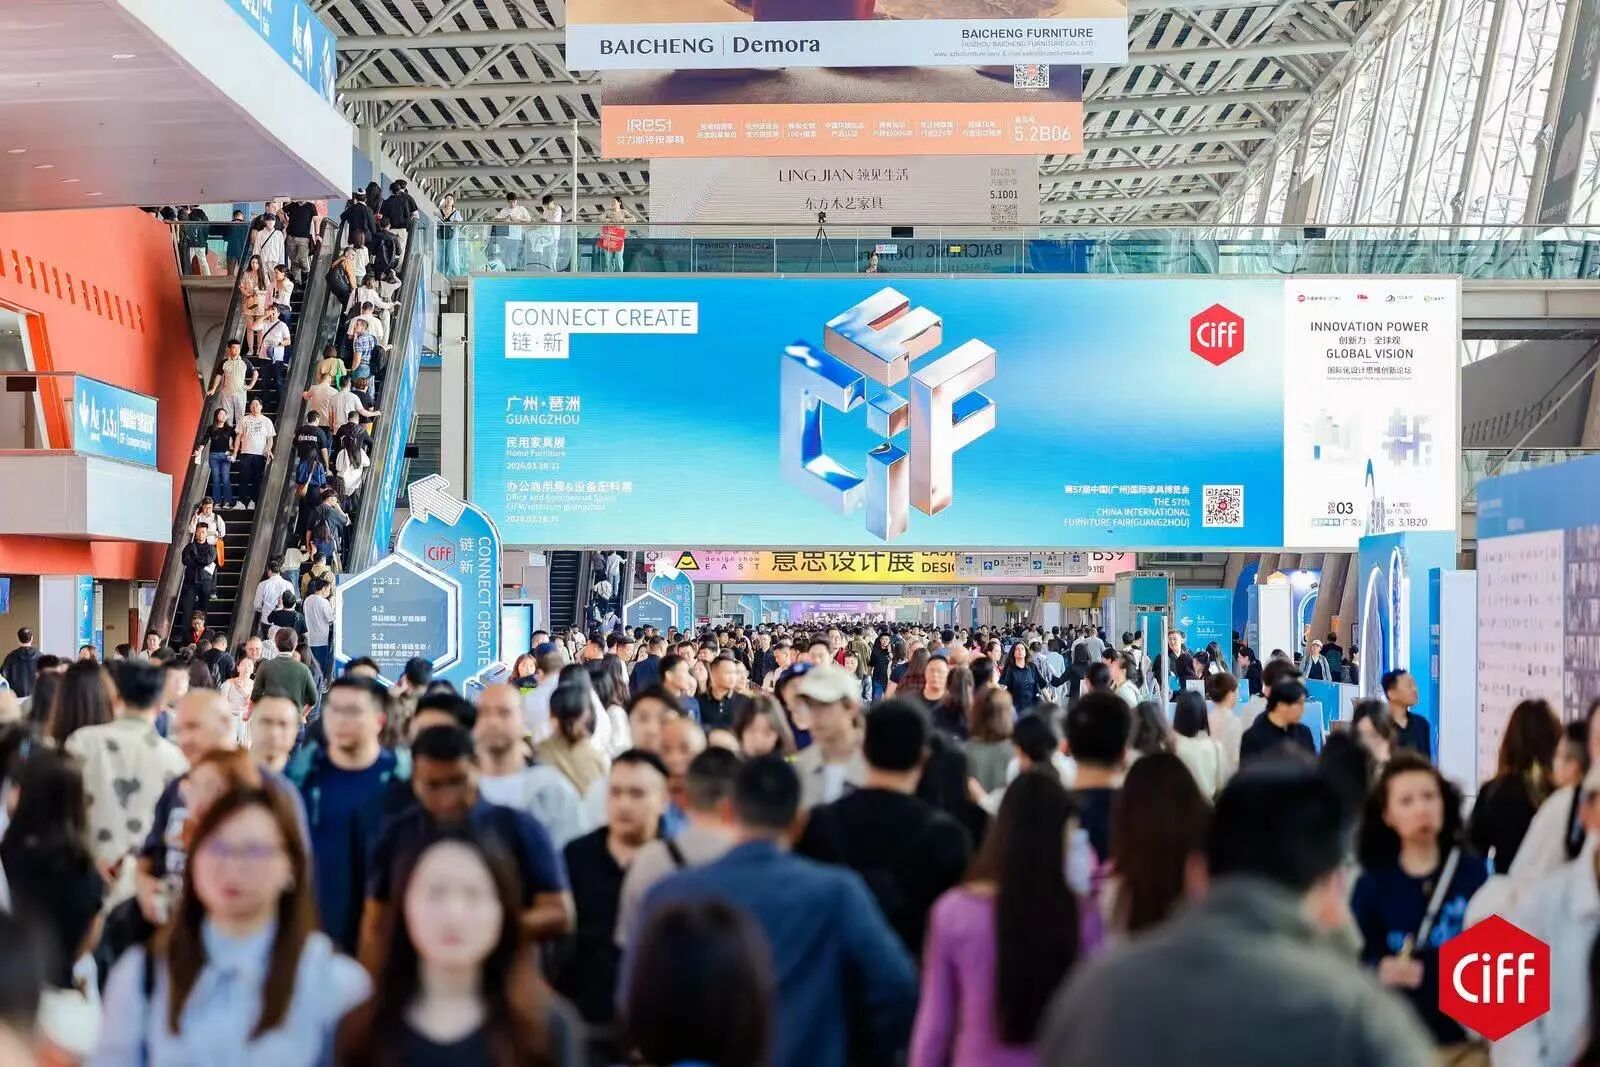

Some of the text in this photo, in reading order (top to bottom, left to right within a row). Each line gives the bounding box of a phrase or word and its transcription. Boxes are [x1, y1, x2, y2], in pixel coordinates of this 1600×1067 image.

[962, 28, 1094, 39] BAICHENG FURNITURE
[599, 36, 821, 55] BAICHENG Demora
[1014, 125, 1072, 142] 5.2B06
[779, 168, 910, 182] LING JIAN 领见生活
[990, 190, 1018, 199] 5.1D01
[804, 197, 885, 210] 东方木艺家具
[511, 308, 692, 327] CONNECT CREATE
[1310, 321, 1429, 332] INNOVATION POWER
[511, 331, 563, 353] 链·新
[1326, 348, 1414, 359] GLOBAL VISION
[1327, 366, 1412, 375] 国际化设计思维创新论坛
[506, 396, 581, 412] 广州·琶洲
[506, 414, 580, 425] GUANGZHOU
[506, 436, 566, 449] 民用家具展
[530, 450, 566, 458] Furniture
[506, 462, 560, 470] 2026.03.18-21
[1153, 498, 1190, 506] THE 57th
[1096, 508, 1190, 517] CHINA INTERNATIONAL
[1336, 501, 1354, 515] 03
[1064, 518, 1190, 528] FURNITURE FAIR(GUANGZHOU)
[372, 577, 400, 585] 1.2-3.2
[477, 536, 492, 666] CONNECT CREATE
[371, 605, 385, 613] 4.2
